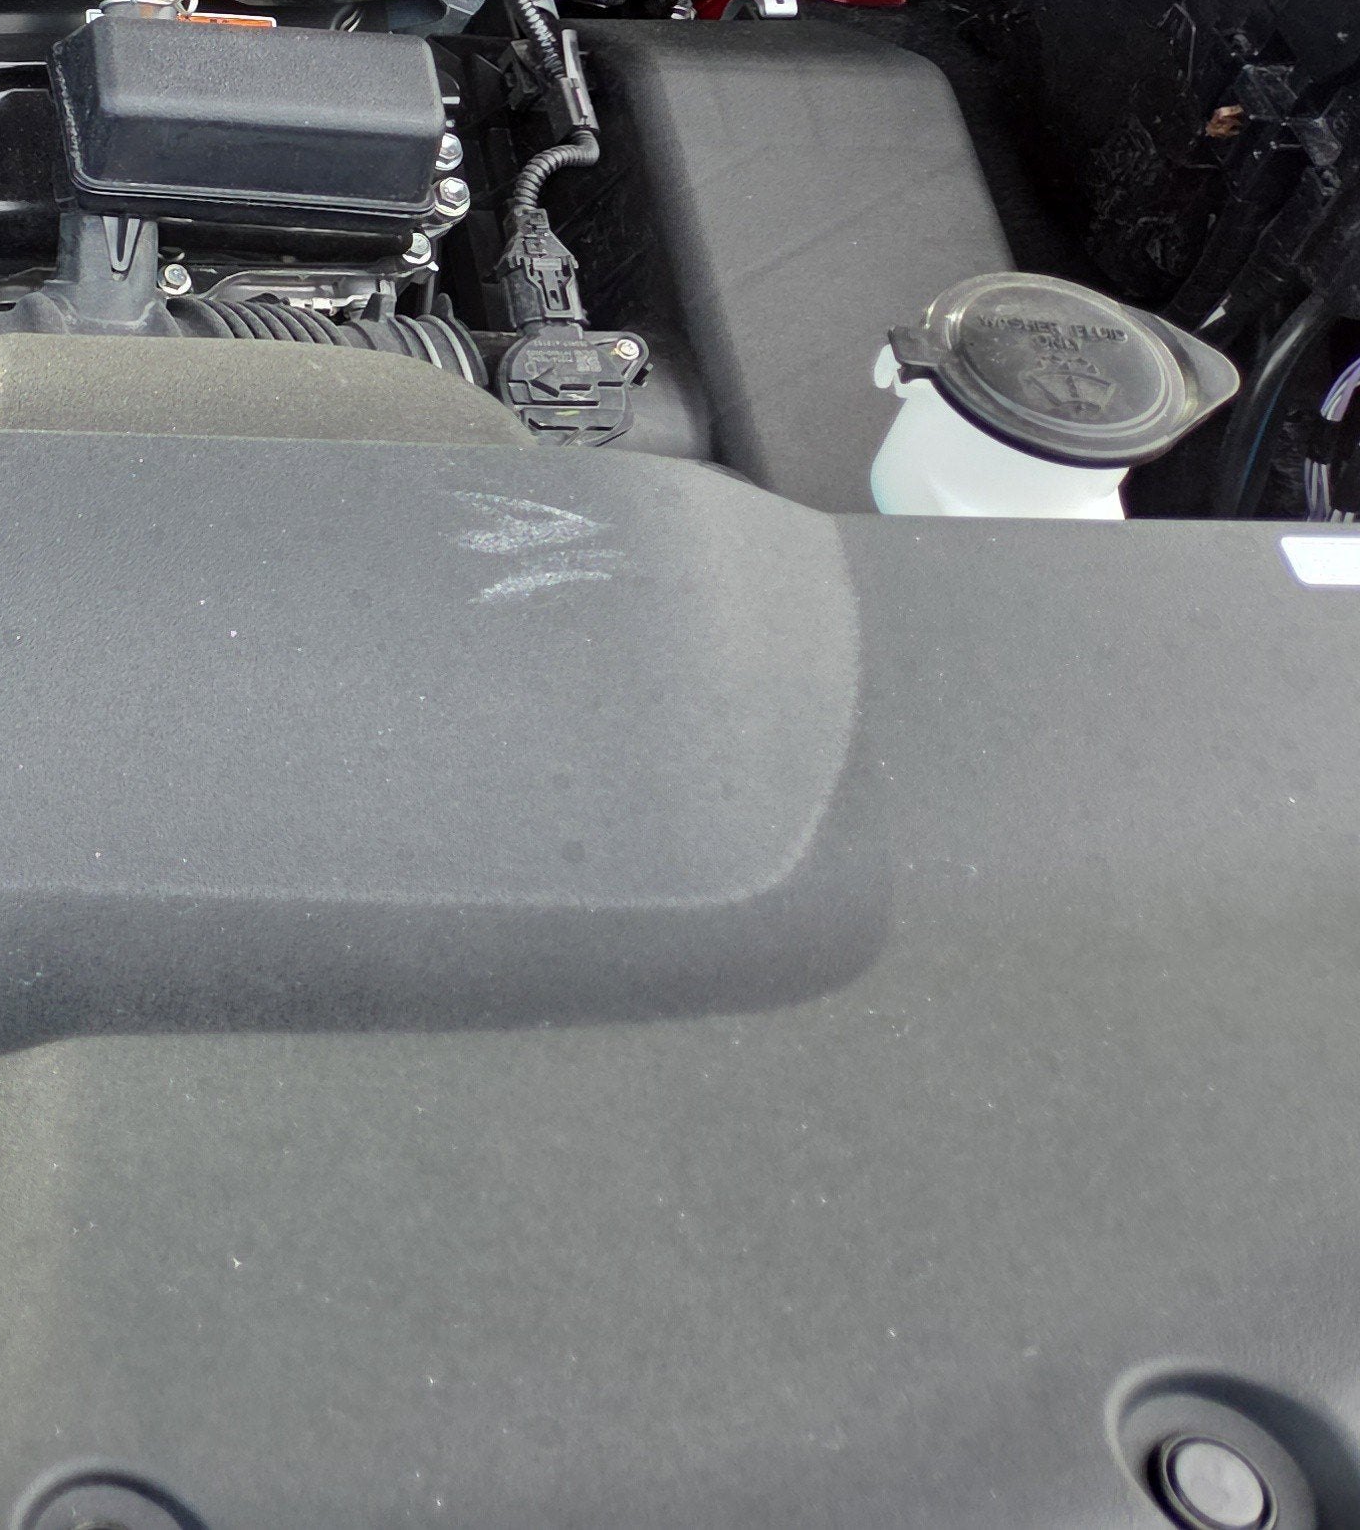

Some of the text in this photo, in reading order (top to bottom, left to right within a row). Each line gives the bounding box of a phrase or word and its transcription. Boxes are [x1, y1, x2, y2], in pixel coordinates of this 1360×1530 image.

[979, 317, 1129, 343] WASHER FLUID
[1033, 334, 1079, 352] ONLY
